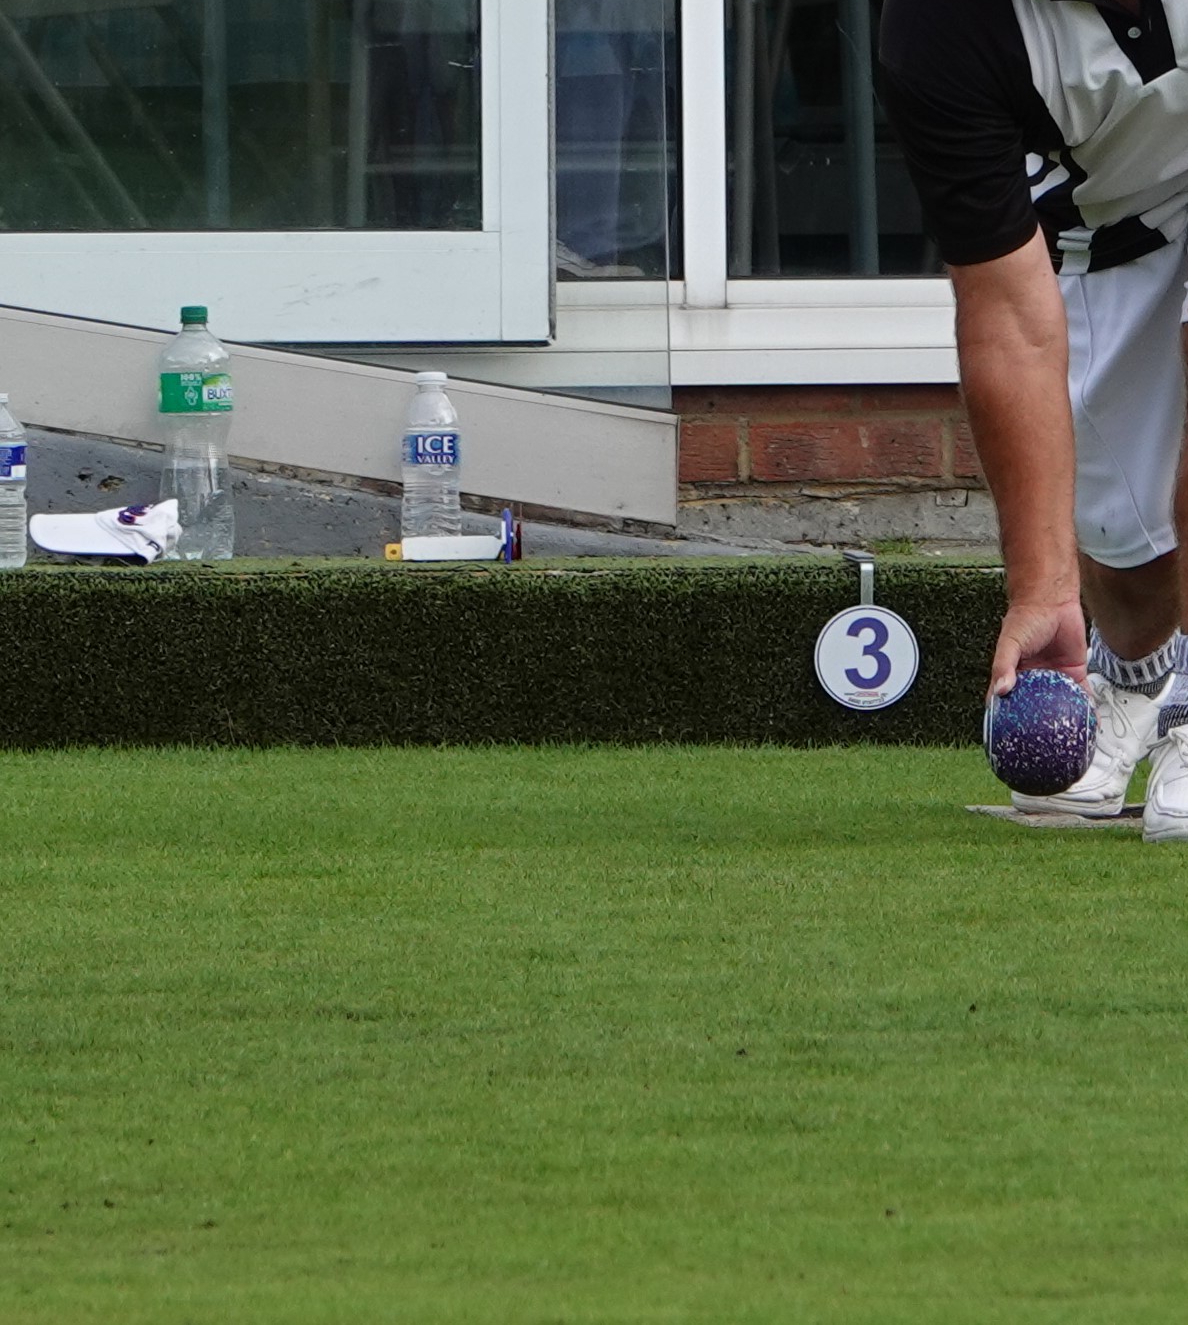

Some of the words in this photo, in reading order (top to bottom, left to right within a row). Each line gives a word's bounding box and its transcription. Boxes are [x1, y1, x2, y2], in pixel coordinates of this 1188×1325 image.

[417, 435, 454, 454] ICE
[416, 455, 456, 464] VALLEY
[845, 617, 891, 689] 3
